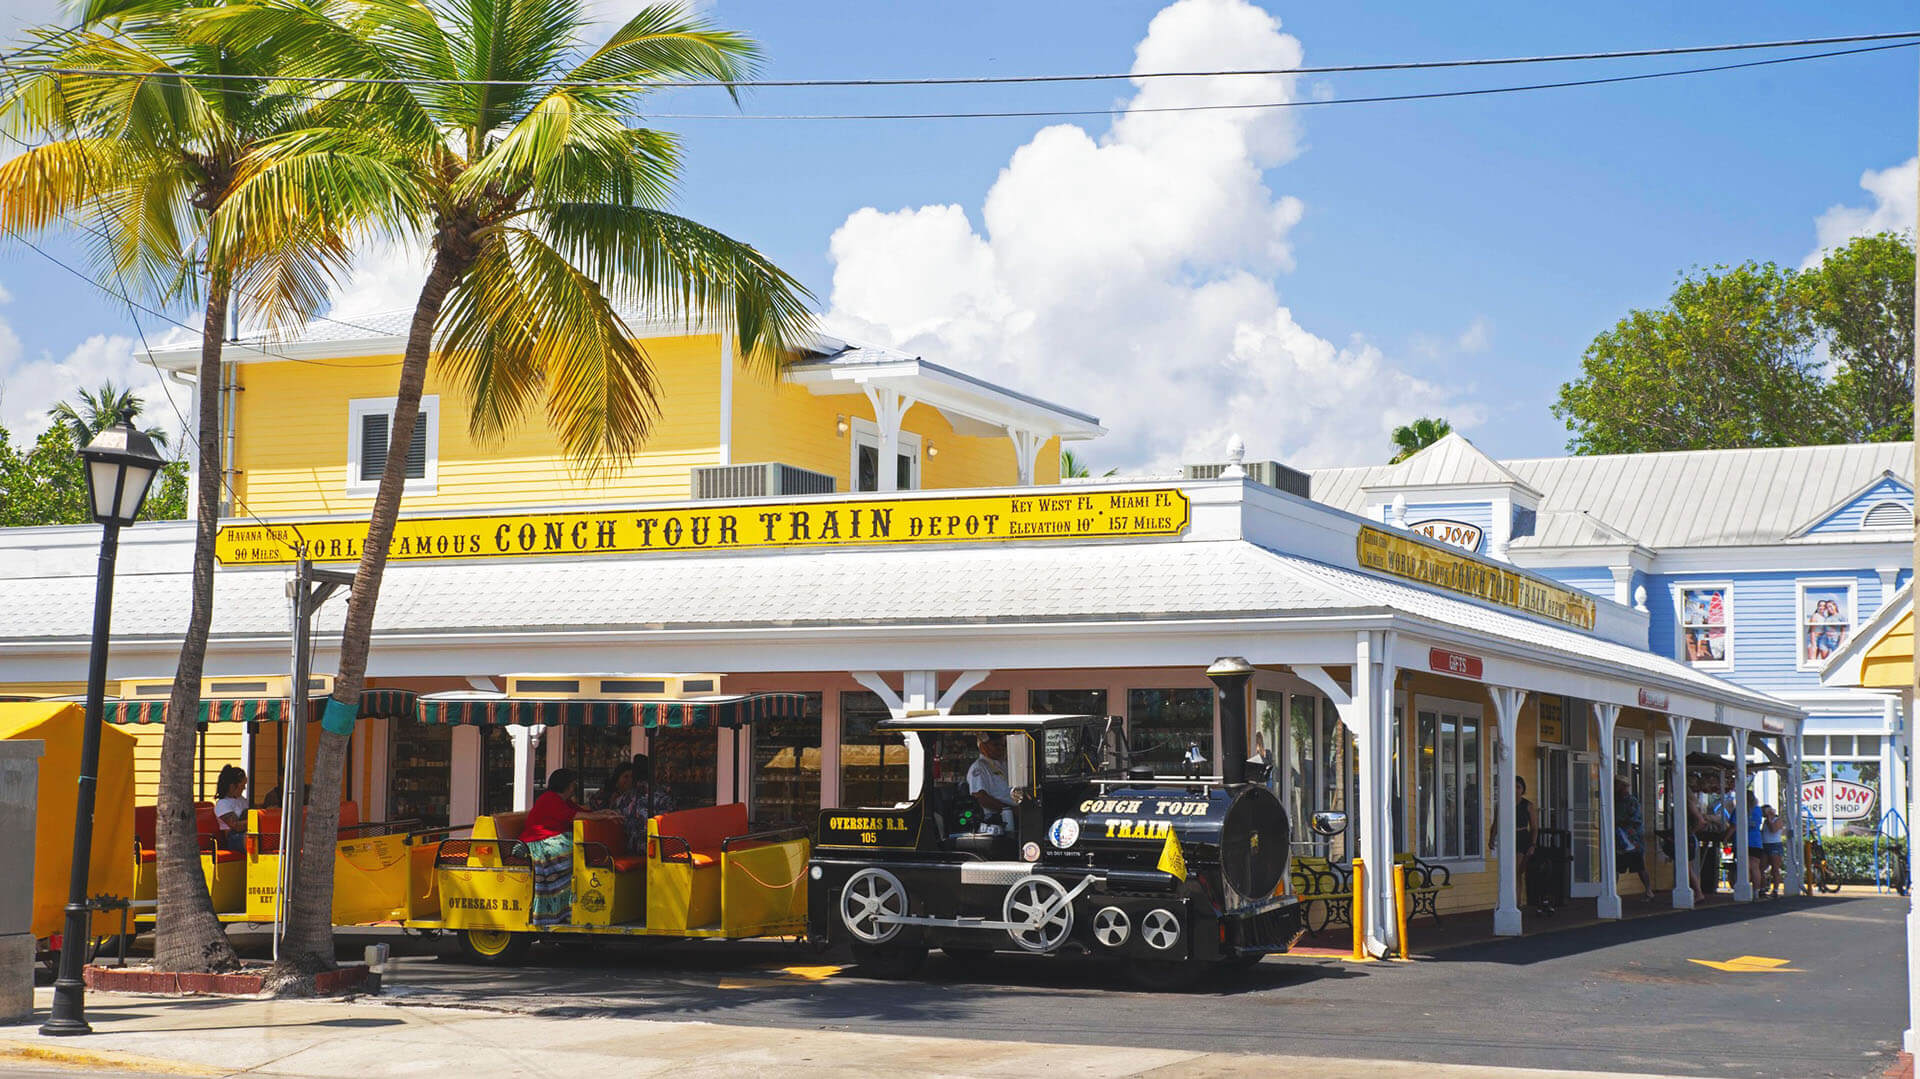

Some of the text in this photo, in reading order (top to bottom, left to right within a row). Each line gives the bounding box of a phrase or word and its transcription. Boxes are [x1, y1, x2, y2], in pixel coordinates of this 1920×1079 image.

[1077, 497, 1093, 510] FL
[1155, 494, 1172, 507] FL
[494, 520, 617, 552] CONCH
[636, 515, 739, 547] TOUR
[759, 508, 893, 541] TRAIN
[909, 514, 999, 536] DEPOT
[1109, 516, 1131, 530] 157
[1439, 526, 1476, 545] JON
[235, 549, 247, 560] 90
[1449, 654, 1467, 673] GIFTS
[1835, 786, 1869, 804] JON
[1079, 800, 1209, 816] CONCH TOUR
[1834, 804, 1860, 813] SHOP
[830, 816, 908, 831] OVERSEAS R.R.
[1105, 819, 1172, 840] TRAIN
[860, 832, 877, 844] 105
[260, 896, 273, 904] KEY
[449, 897, 523, 911] OVERSEAS R.R.
